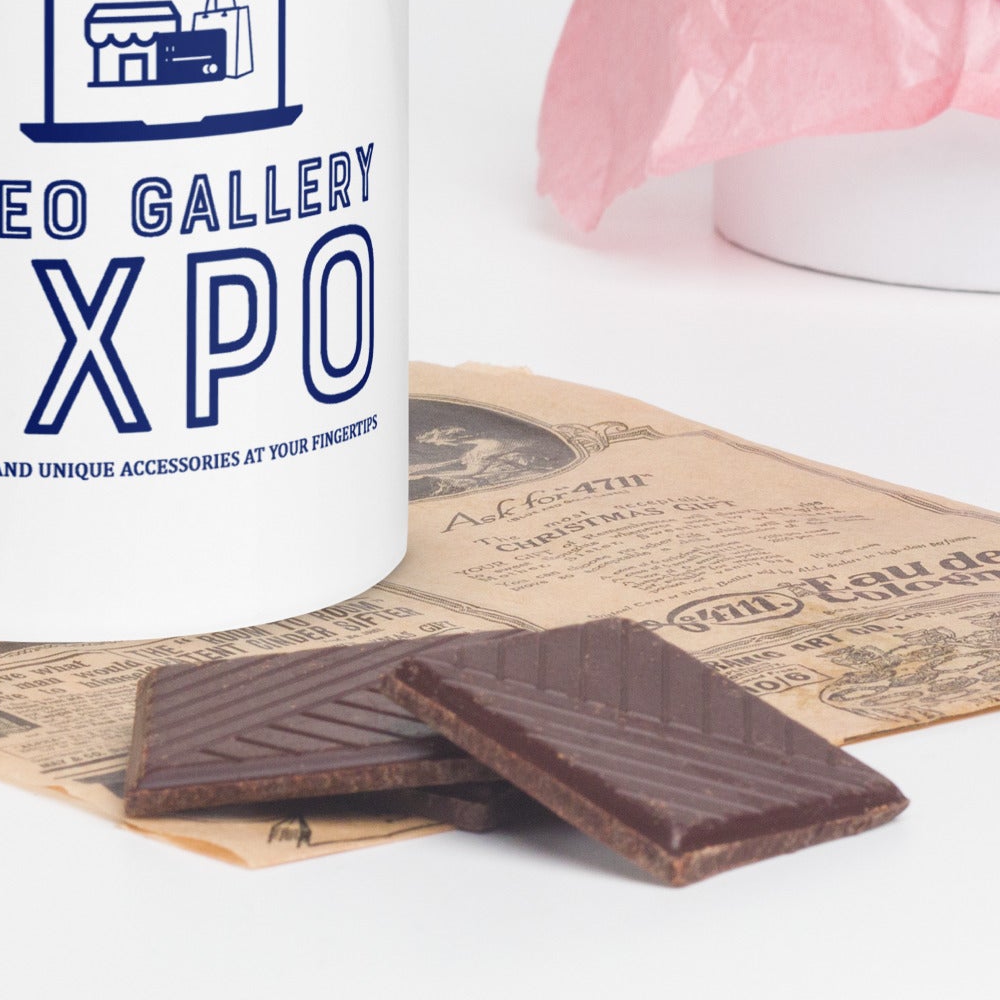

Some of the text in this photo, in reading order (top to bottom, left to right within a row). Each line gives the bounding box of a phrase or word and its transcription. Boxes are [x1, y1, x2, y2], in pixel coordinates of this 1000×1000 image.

[131, 142, 375, 238] GALLERY
[39, 461, 116, 482] UNIQUE
[120, 452, 241, 477] ACCESSORIES
[243, 446, 265, 465] AT
[269, 437, 310, 460] YOUR
[312, 415, 378, 451] FINGERTIPS
[440, 498, 517, 533] Ask
[521, 489, 569, 509] for
[472, 535, 521, 546] The
[543, 510, 590, 528] most
[613, 495, 719, 510] acceptable
[495, 507, 665, 552] CHRISTMAS
[673, 500, 737, 512] GIFT
[452, 560, 508, 576] YOUR
[513, 549, 554, 561] GIFT
[800, 560, 935, 592] Eau
[938, 550, 1000, 571] de
[124, 644, 182, 662] THE
[271, 616, 312, 632] TO
[245, 625, 339, 650] CINDER
[333, 606, 424, 632] SIFTER
[791, 633, 844, 652] ART
[11, 676, 66, 690] man
[72, 659, 147, 679] would
[30, 659, 92, 676] what
[37, 687, 67, 696] to
